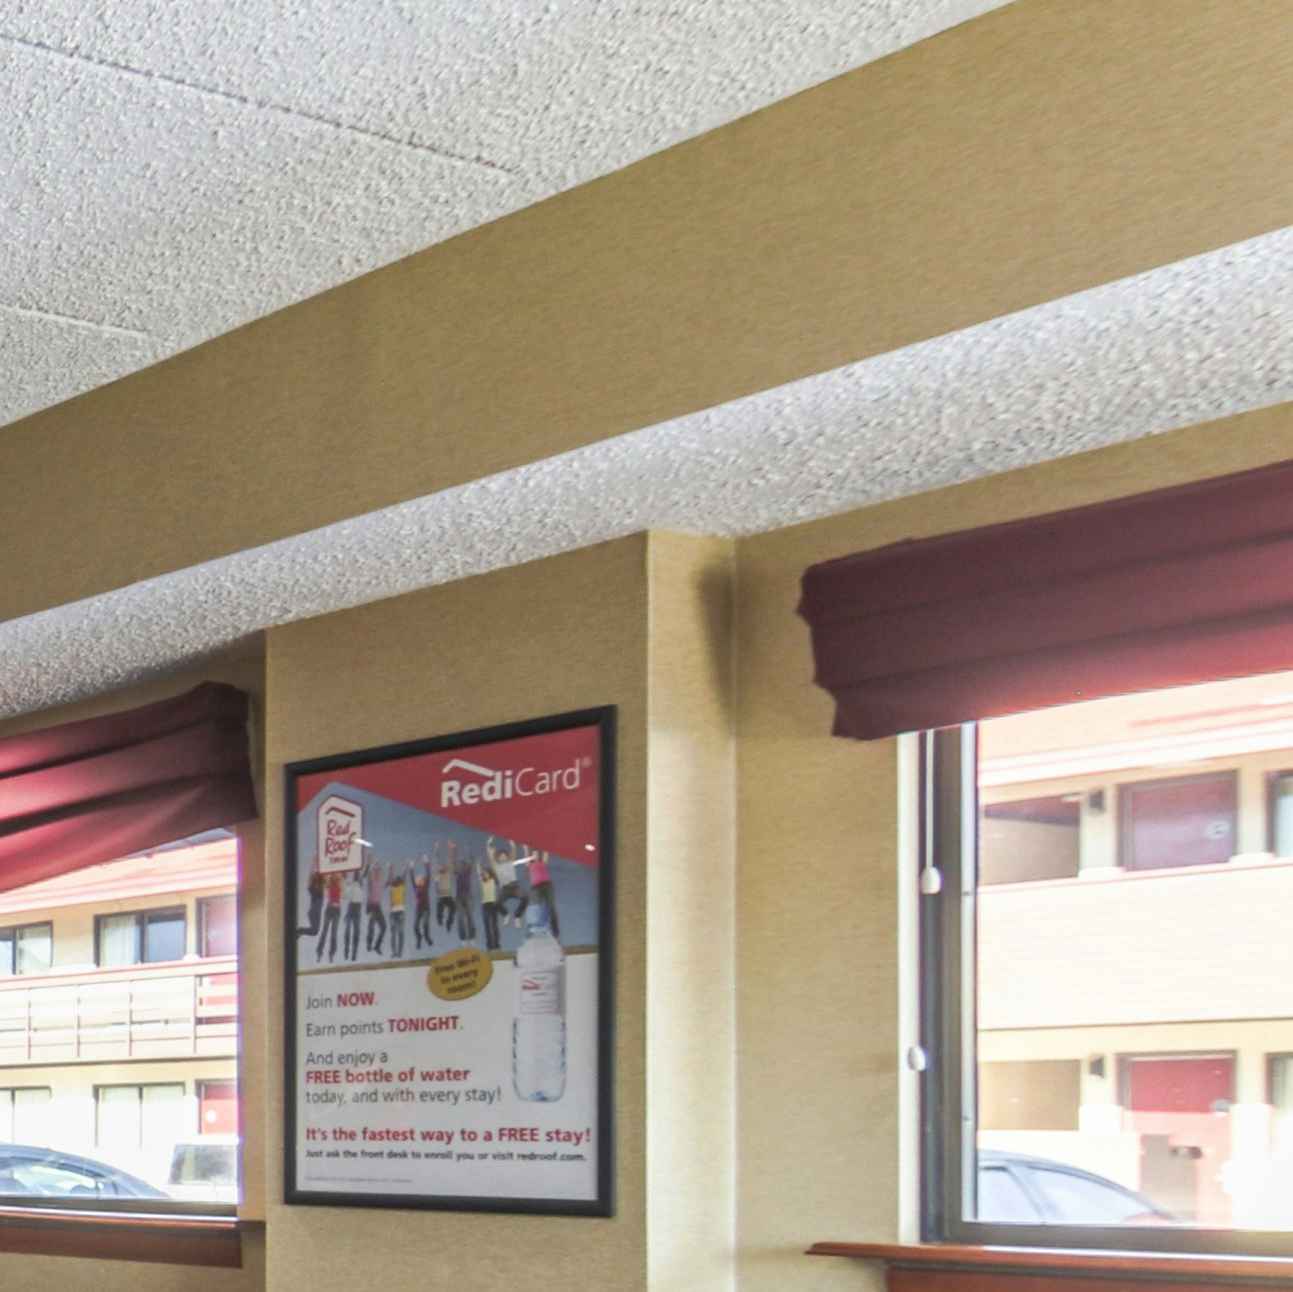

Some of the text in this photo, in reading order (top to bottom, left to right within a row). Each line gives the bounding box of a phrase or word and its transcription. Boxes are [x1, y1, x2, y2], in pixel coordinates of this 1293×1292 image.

[326, 819, 351, 836] Red
[324, 831, 357, 857] Roof
[306, 992, 379, 1010] Join NOW.
[306, 1016, 464, 1038] Earn points TONIGHT.
[306, 1051, 388, 1068] And enjoy a
[306, 1067, 471, 1084] FREE bottle of water
[306, 1086, 502, 1106] today, and with every stay!
[333, 1127, 357, 1141] the
[361, 1127, 415, 1141] fastest
[420, 1130, 455, 1145] way
[460, 1128, 478, 1141] to
[483, 1131, 493, 1141] a
[498, 1127, 540, 1142] FREE
[546, 1127, 591, 1146] stay!
[306, 1150, 323, 1158] Just
[326, 1149, 340, 1158] ask
[343, 1149, 357, 1158] the
[360, 1149, 384, 1158] front
[387, 1149, 408, 1159] desk
[411, 1150, 421, 1159] to
[424, 1150, 454, 1160] enroll
[456, 1152, 475, 1162] you
[478, 1152, 489, 1160] or
[492, 1151, 514, 1161] visit
